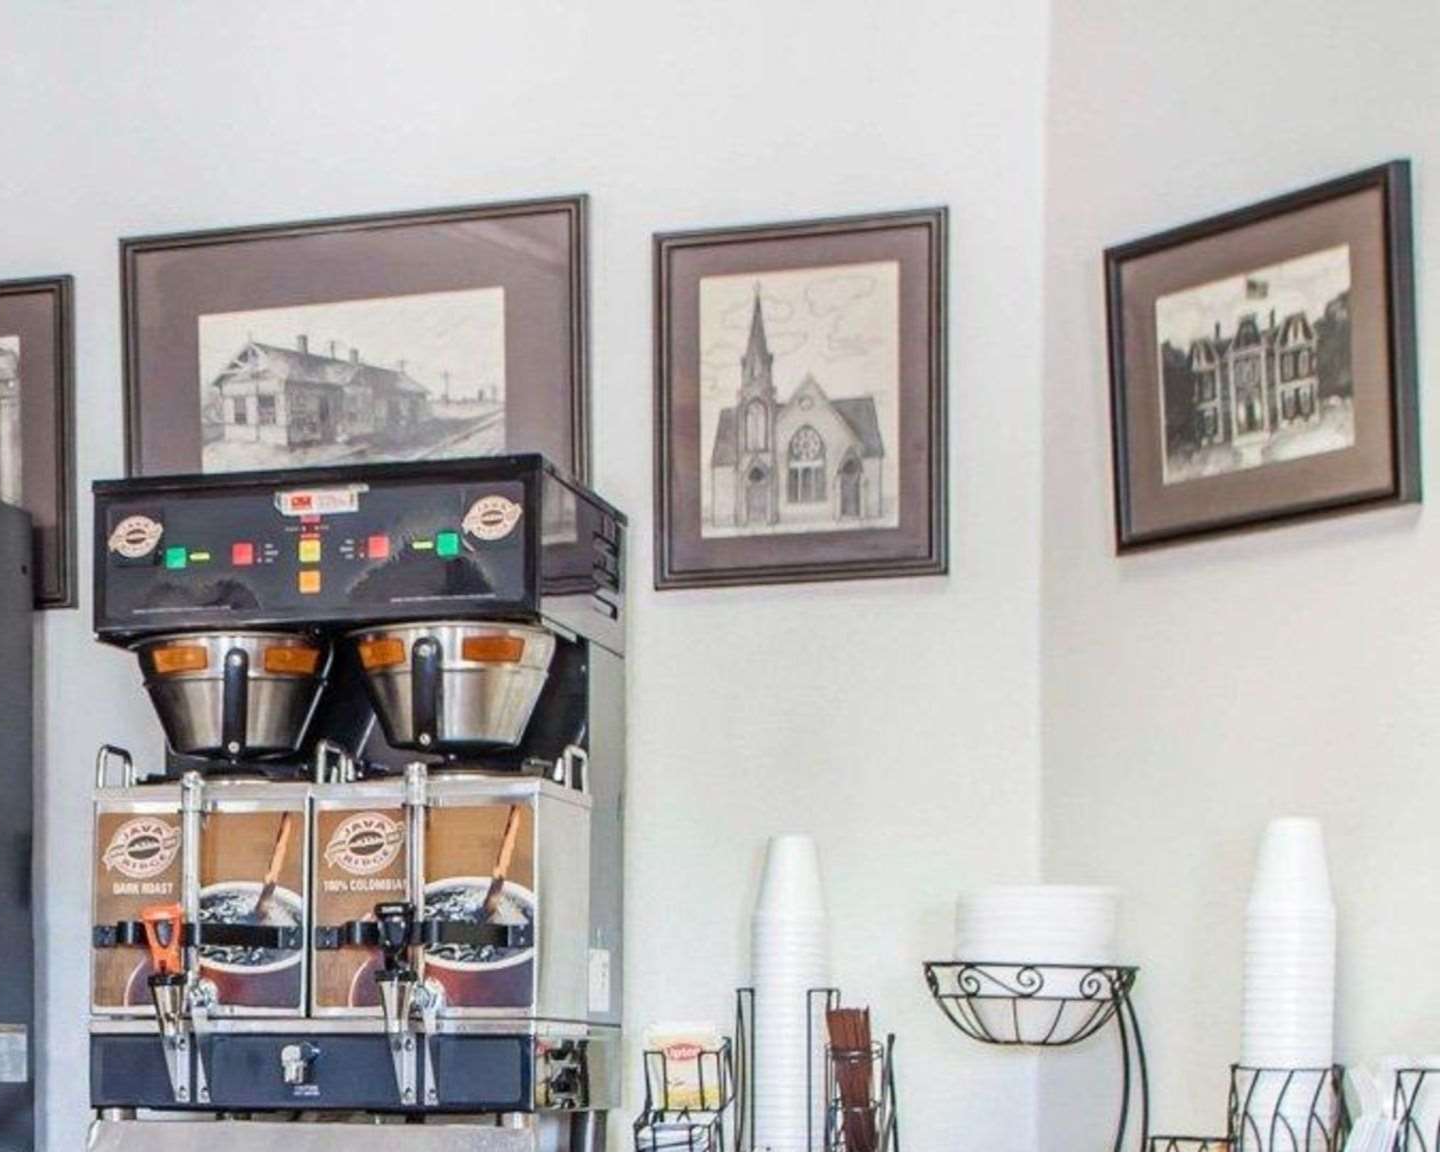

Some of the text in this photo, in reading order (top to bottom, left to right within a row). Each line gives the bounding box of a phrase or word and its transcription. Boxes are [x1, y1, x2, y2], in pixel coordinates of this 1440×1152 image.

[123, 824, 164, 841] JAVA
[344, 820, 386, 836] JAVA
[113, 882, 174, 895] DARK ROAST
[323, 880, 348, 893] 100%
